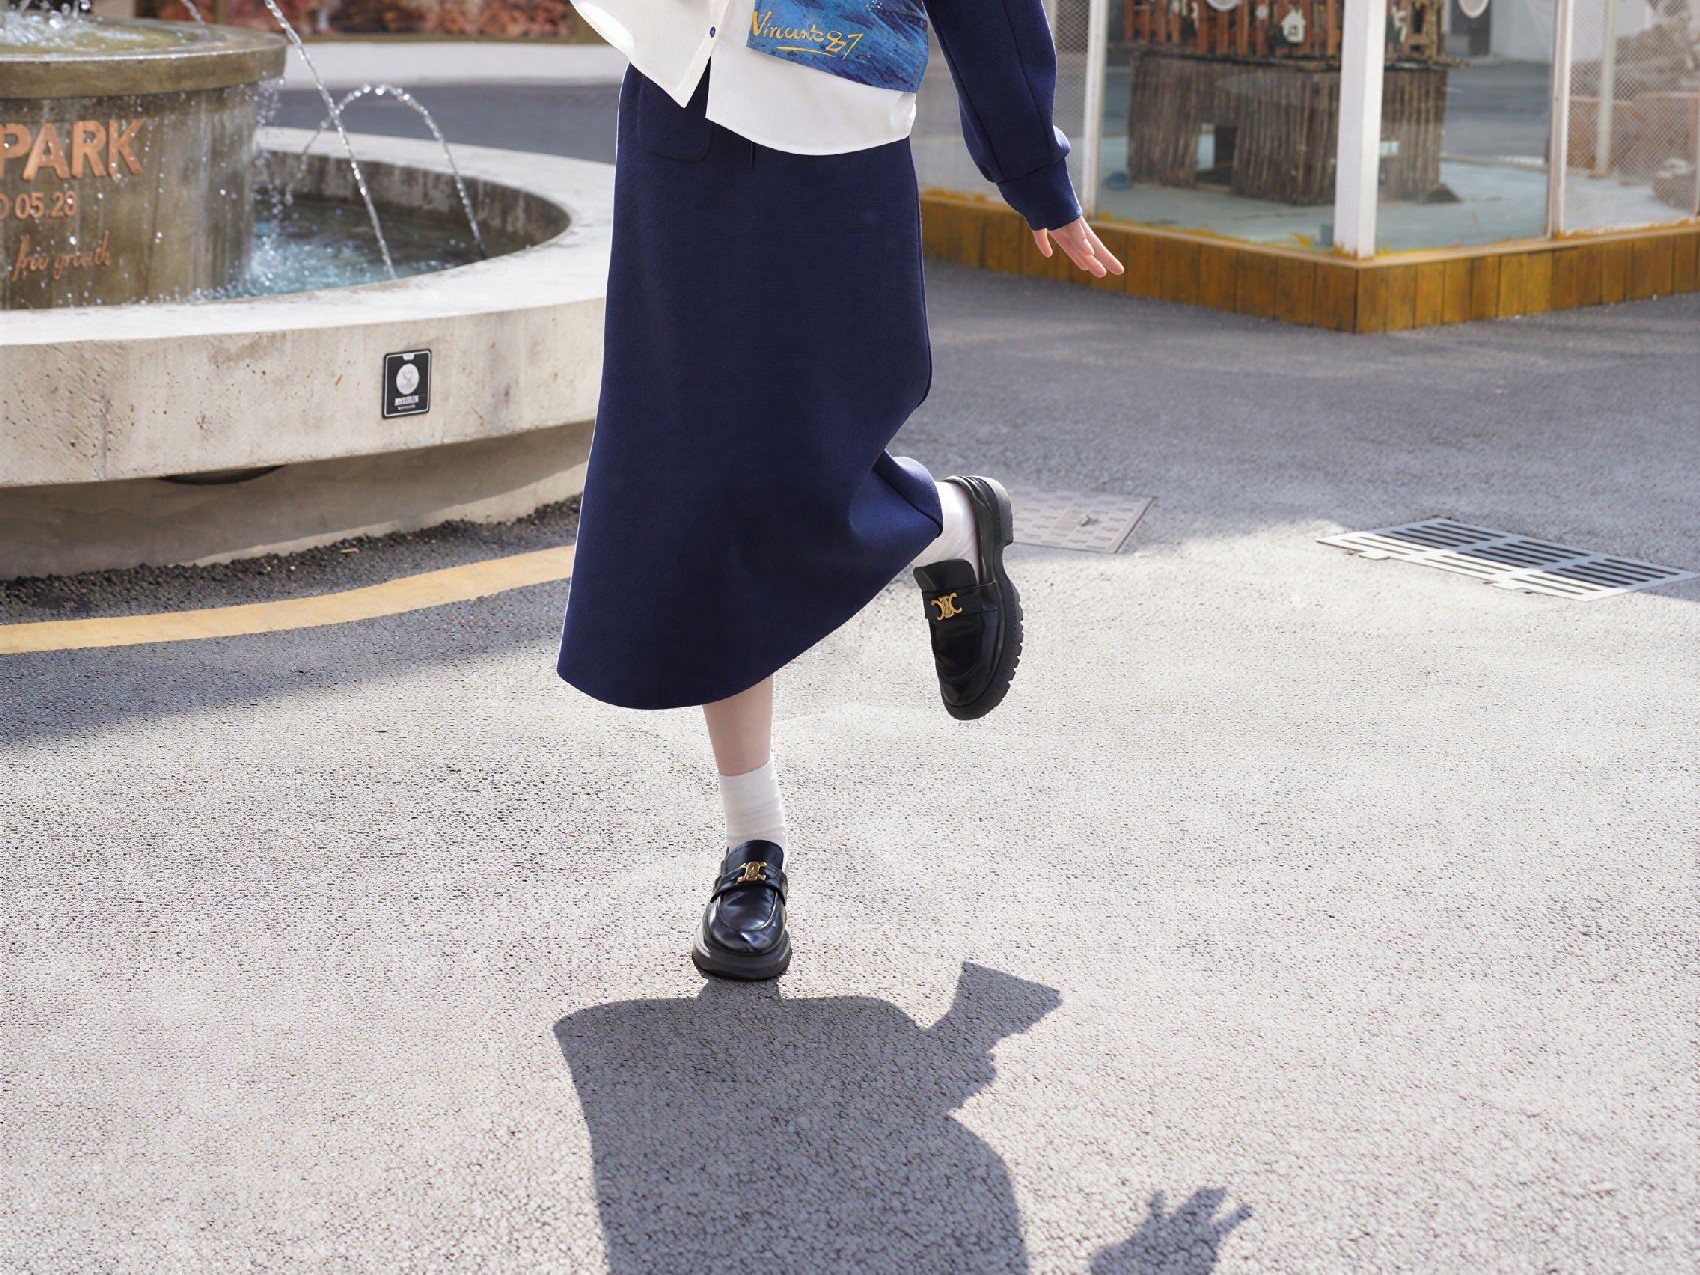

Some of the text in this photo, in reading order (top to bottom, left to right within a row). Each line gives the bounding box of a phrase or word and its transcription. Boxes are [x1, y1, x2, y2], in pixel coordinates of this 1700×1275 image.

[0, 119, 145, 182] PARK
[15, 192, 45, 220] 05
[51, 190, 77, 218] 28
